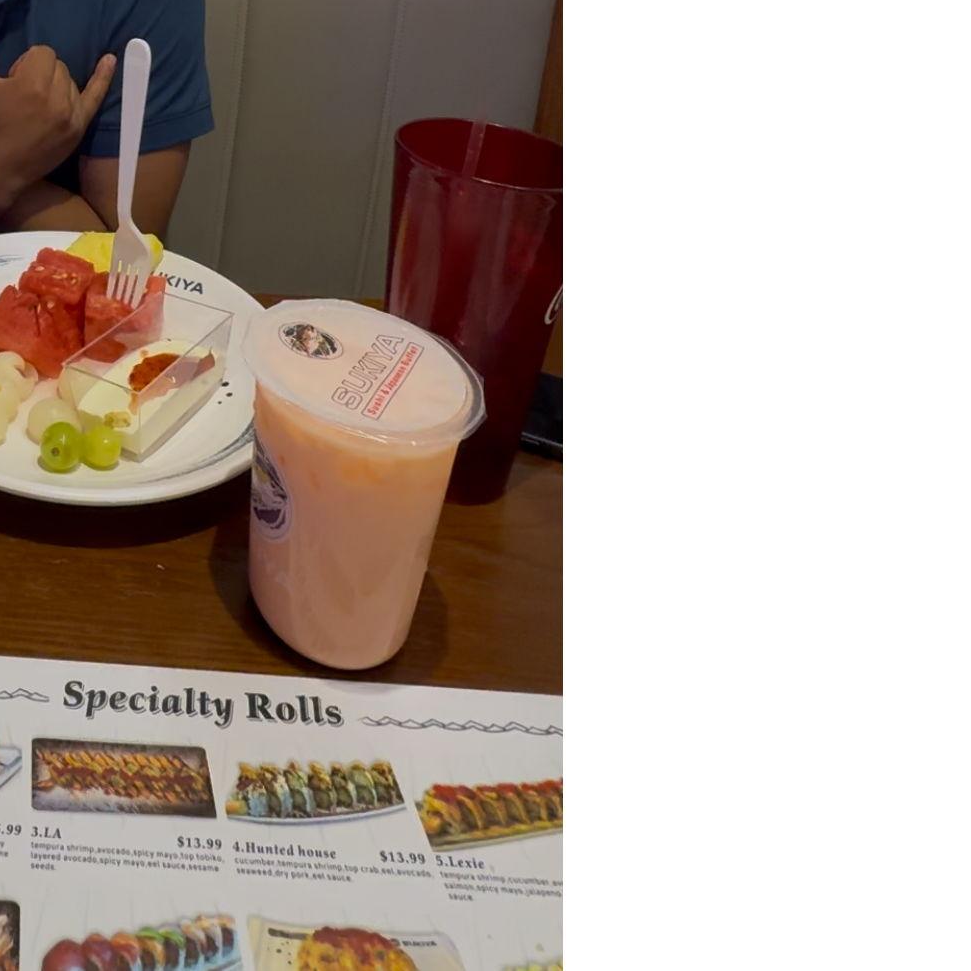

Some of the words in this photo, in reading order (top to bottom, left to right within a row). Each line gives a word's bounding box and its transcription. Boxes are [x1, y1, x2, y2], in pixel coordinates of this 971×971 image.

[151, 271, 203, 294] KIYA
[331, 334, 406, 410] SUKIYA
[365, 393, 386, 416] Sushi
[399, 344, 419, 367] Buffet
[63, 680, 232, 729] Specialty
[245, 692, 344, 726] Rolls
[31, 826, 62, 839] 3.LA
[31, 841, 64, 851] tempura
[177, 836, 221, 850] $13.99
[233, 841, 294, 856] 4.Hunted
[297, 845, 336, 859] house
[380, 851, 425, 864] $13.99
[436, 854, 485, 869] 5.Lexie
